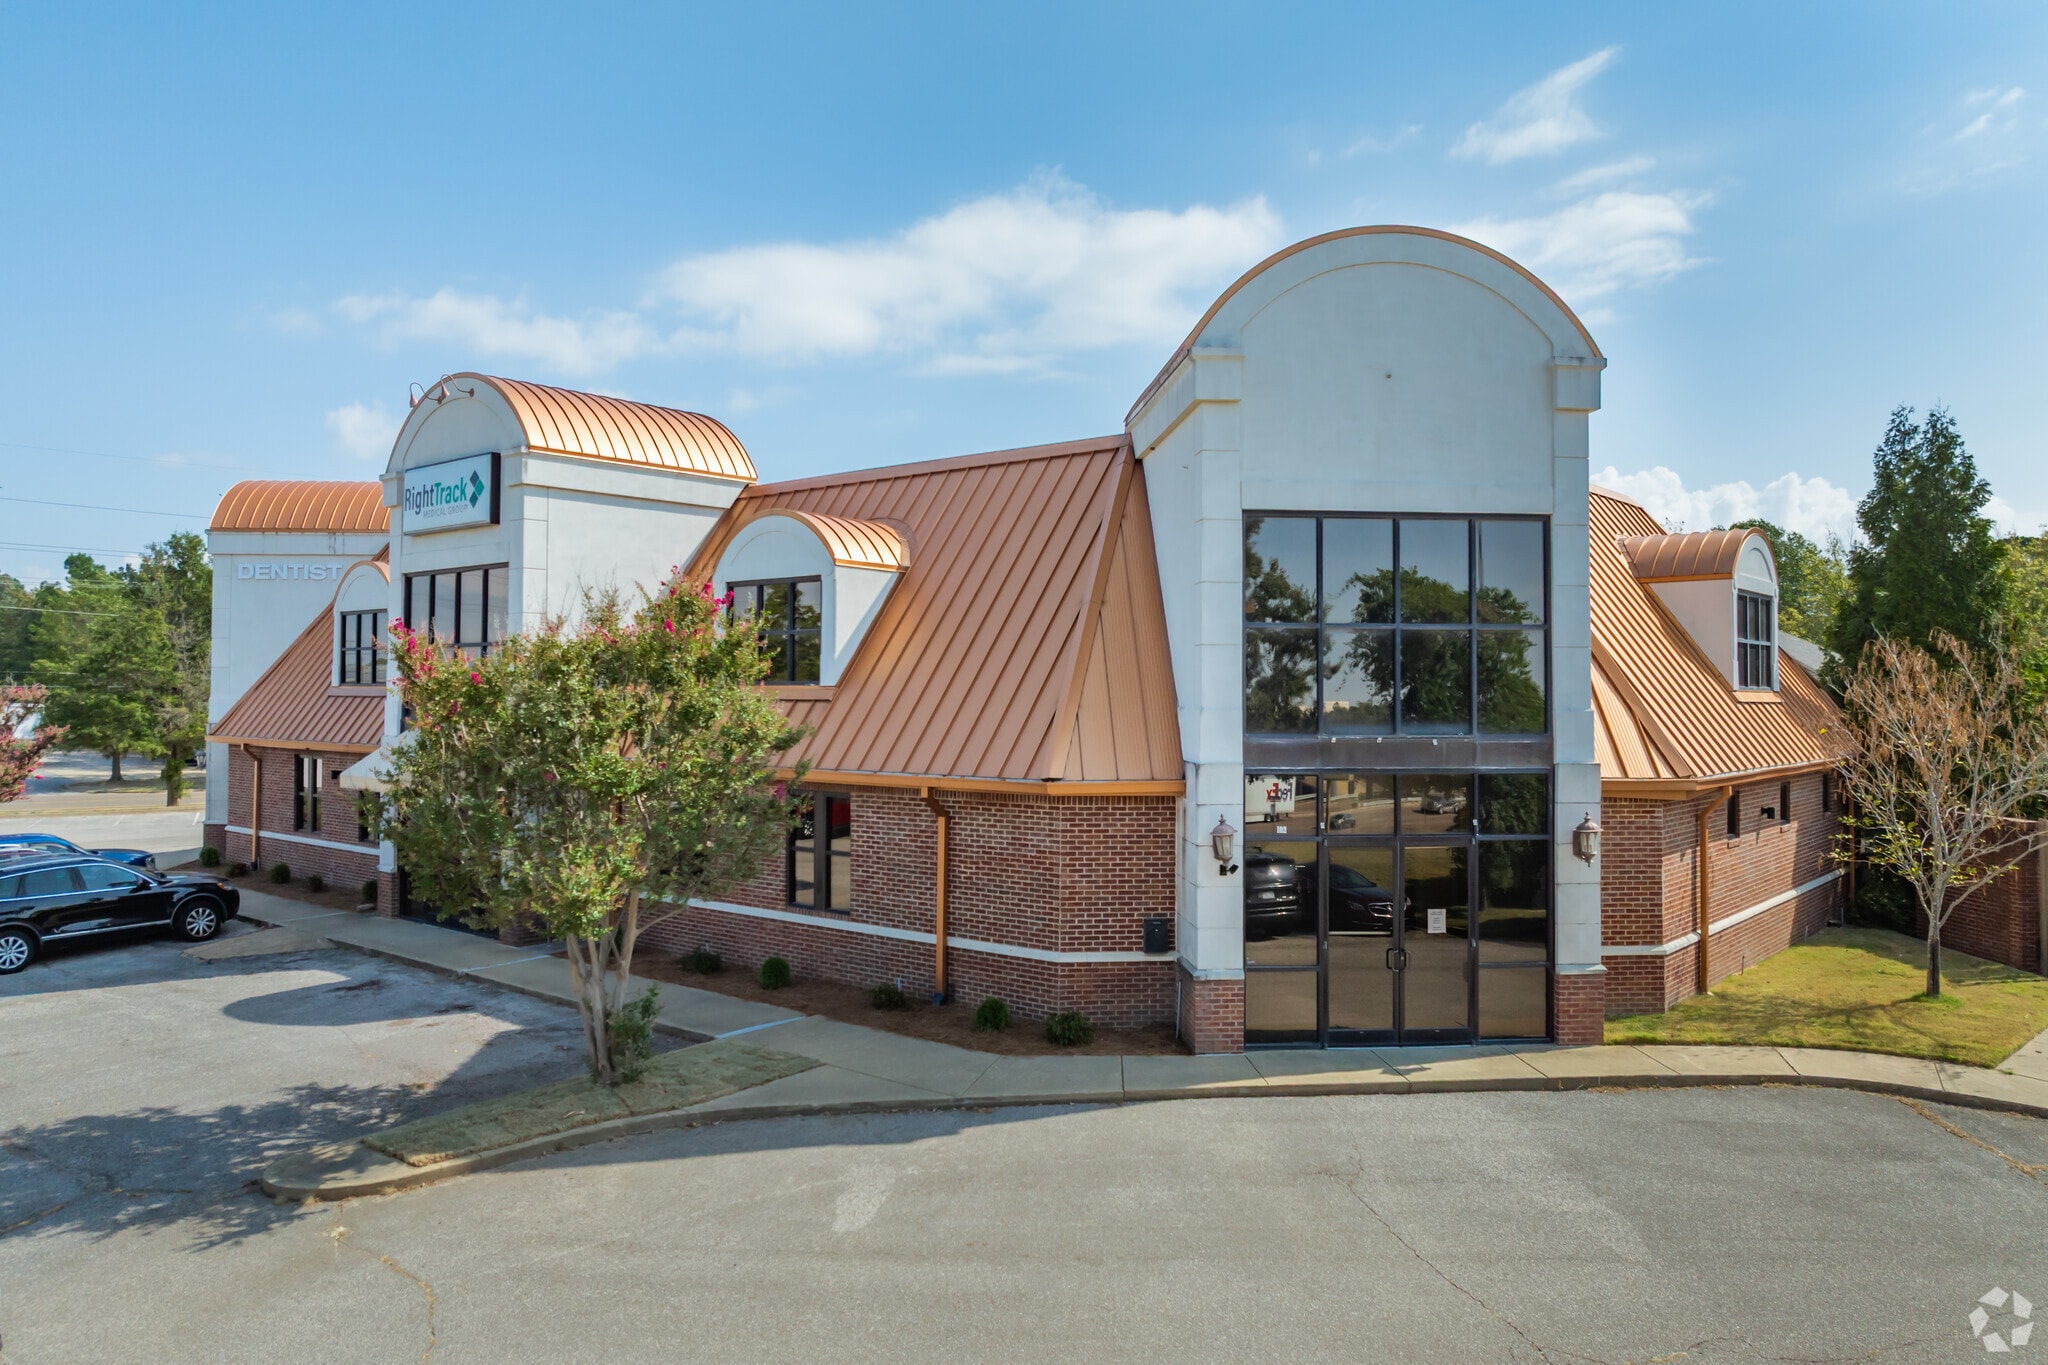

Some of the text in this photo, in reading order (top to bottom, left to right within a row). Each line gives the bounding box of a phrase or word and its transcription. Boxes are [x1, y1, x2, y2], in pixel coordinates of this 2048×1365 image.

[405, 477, 467, 515] RightTrack
[423, 504, 467, 518] MEDICAL GROUP
[238, 563, 343, 581] DENTIST
